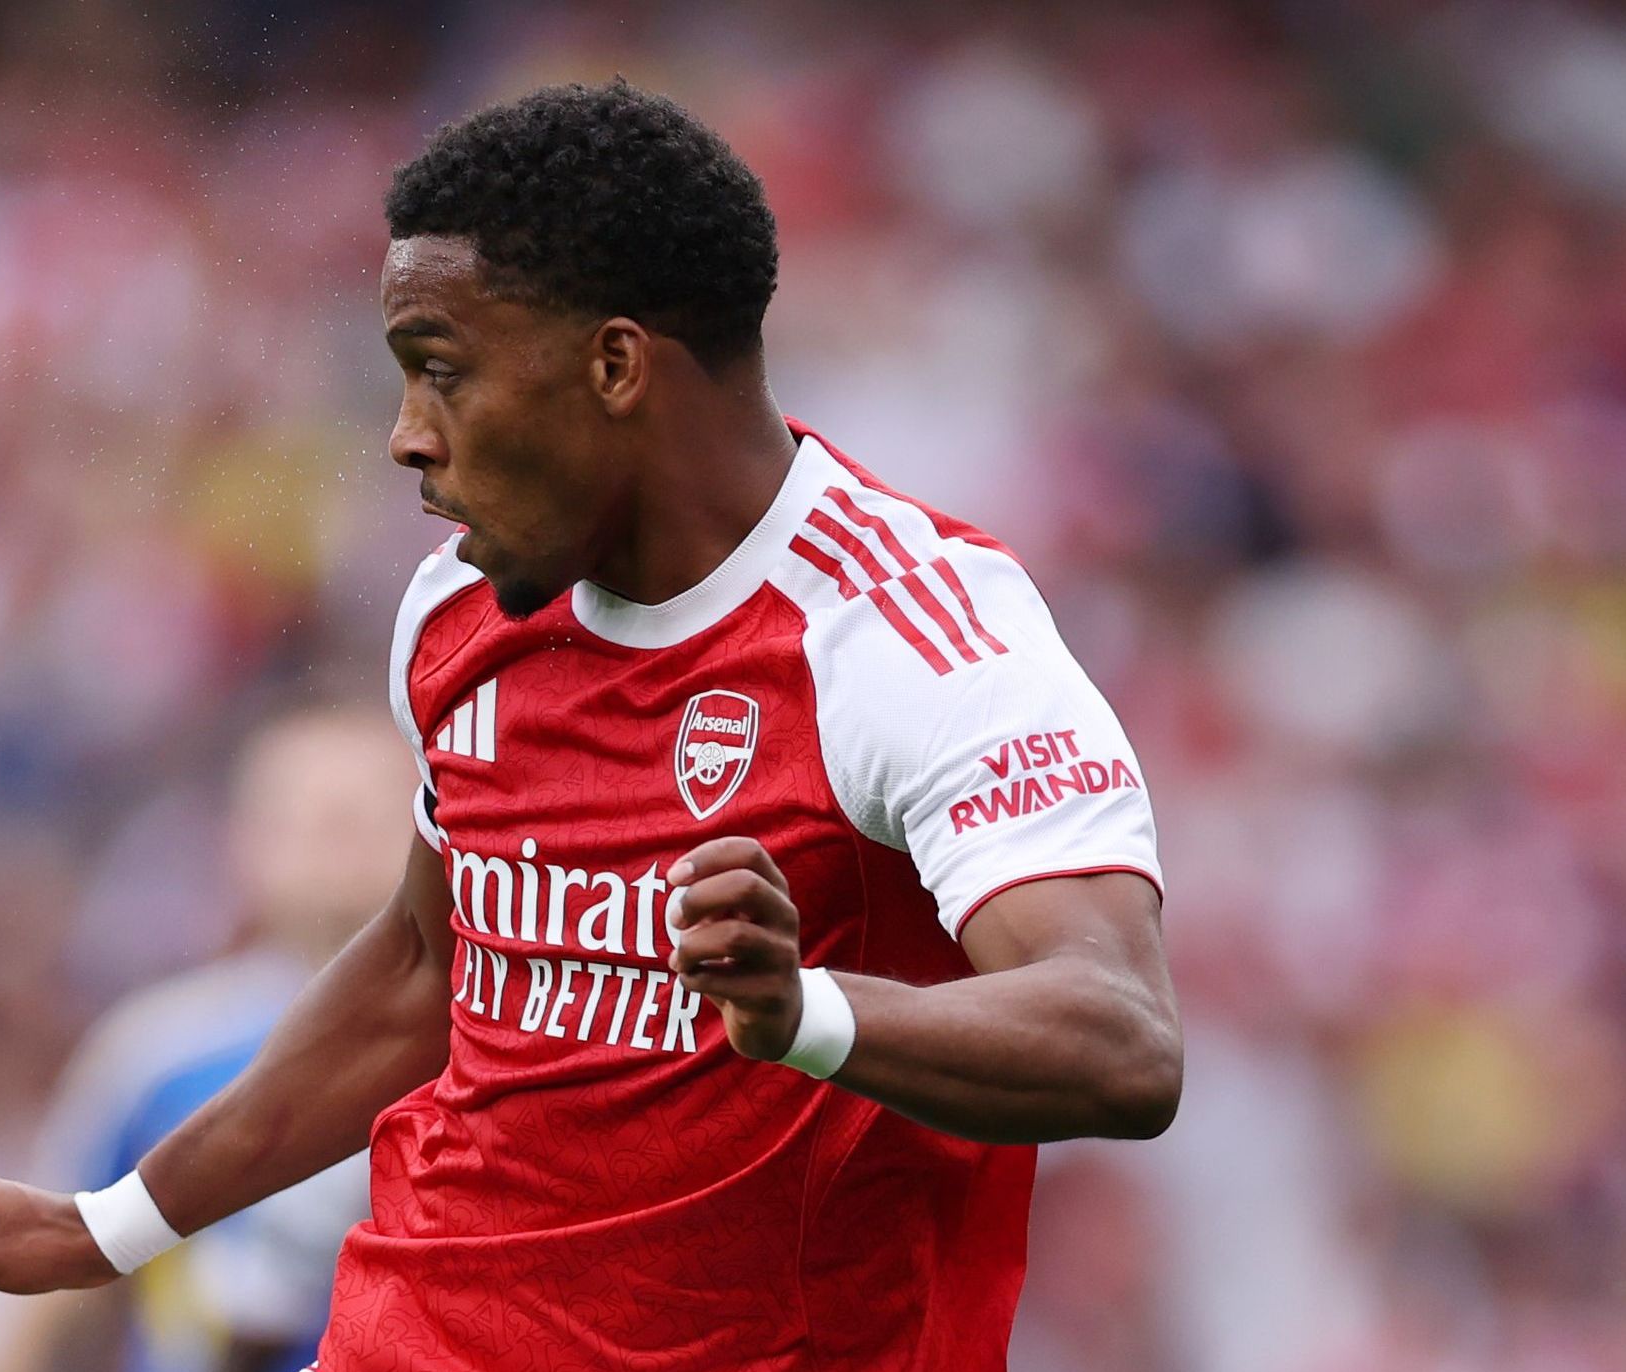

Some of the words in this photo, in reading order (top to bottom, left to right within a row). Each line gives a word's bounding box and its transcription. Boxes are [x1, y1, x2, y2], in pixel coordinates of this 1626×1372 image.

[690, 711, 748, 736] Arsenal
[979, 729, 1081, 779] VISIT
[949, 759, 1141, 835] RWANDA
[438, 826, 690, 958] mirat
[519, 957, 702, 1053] BETTER
